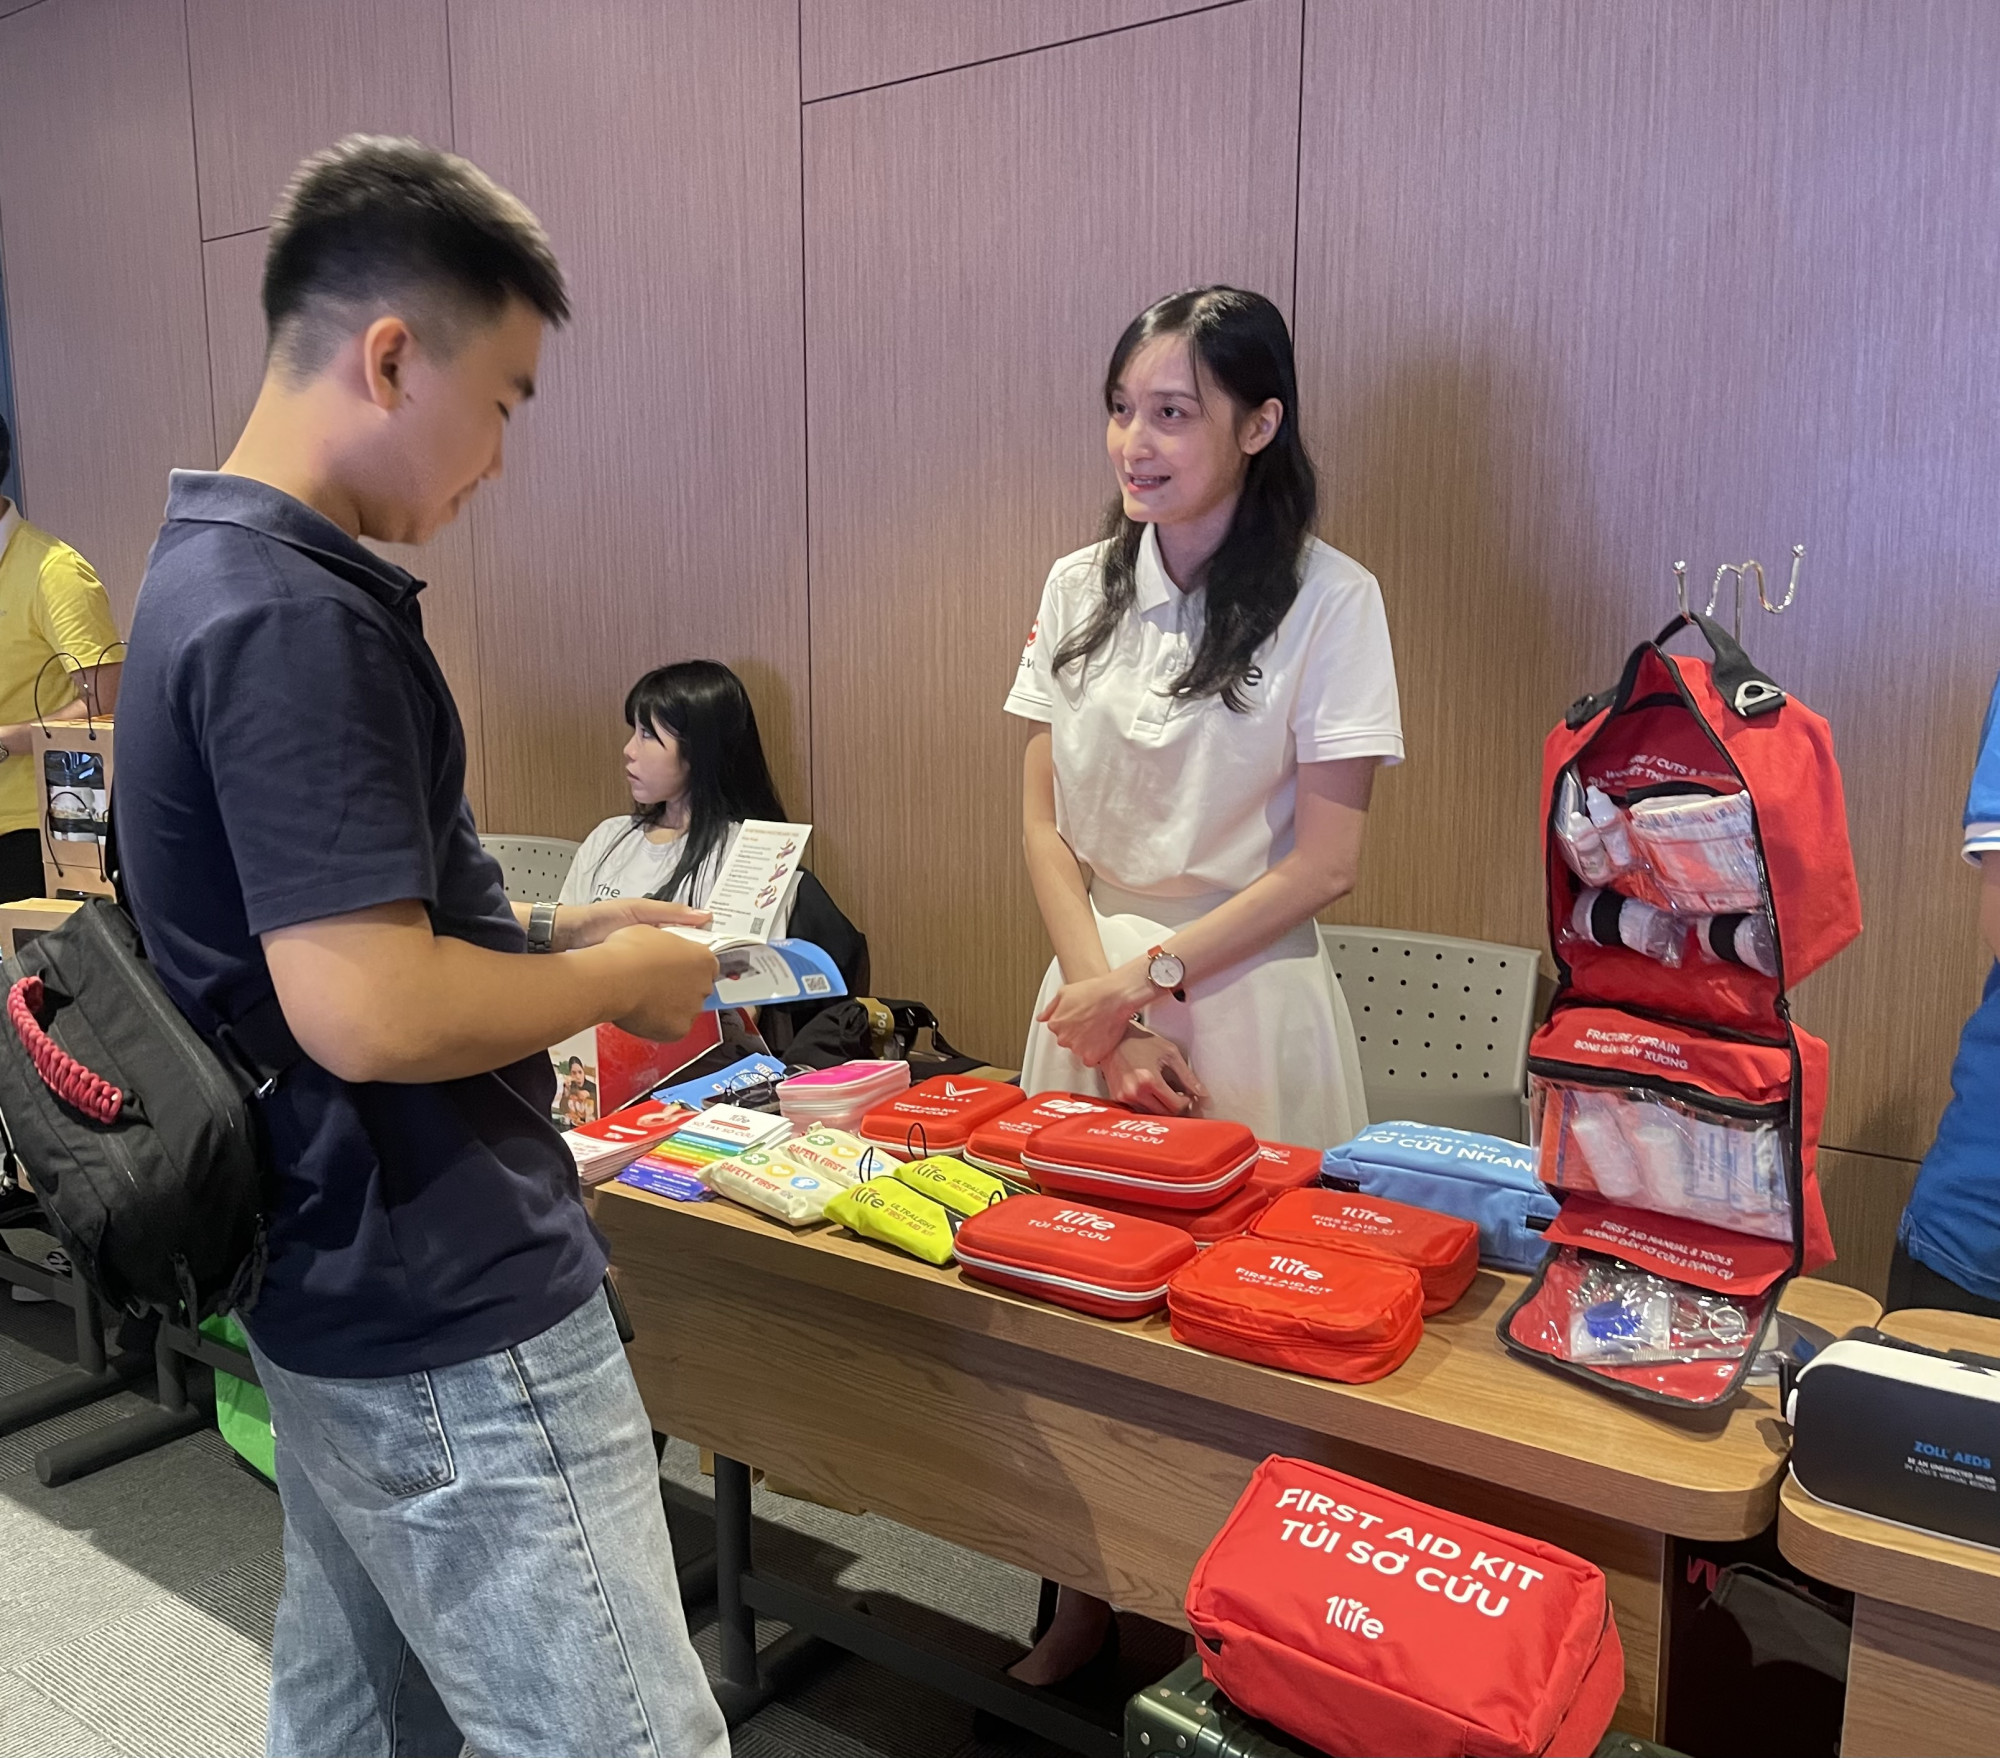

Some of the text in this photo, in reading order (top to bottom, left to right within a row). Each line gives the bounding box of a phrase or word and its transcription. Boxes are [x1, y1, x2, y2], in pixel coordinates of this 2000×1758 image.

[596, 883, 620, 898] The
[1111, 1120, 1169, 1135] 1life
[788, 1144, 847, 1172] SAFETY FIRST
[720, 1162, 753, 1180] SAFETY
[752, 1173, 780, 1192] FIRST
[883, 1207, 907, 1222] FIRST
[890, 1202, 937, 1230] ULTRALIGHT
[1053, 1210, 1115, 1230] 1life
[1342, 1206, 1393, 1224] 1life
[1601, 1220, 1629, 1235] FIRST
[1628, 1230, 1647, 1241] AID
[1699, 1250, 1734, 1266] TOOLS
[1235, 1267, 1277, 1282] FIRST
[1269, 1256, 1324, 1280] 1life
[1914, 1440, 1949, 1460] ZOLL
[1275, 1488, 1544, 1591] FIRST AID KIT
[1280, 1519, 1510, 1618] TÚI SƠ CỨU
[1325, 1595, 1385, 1640] 1life
